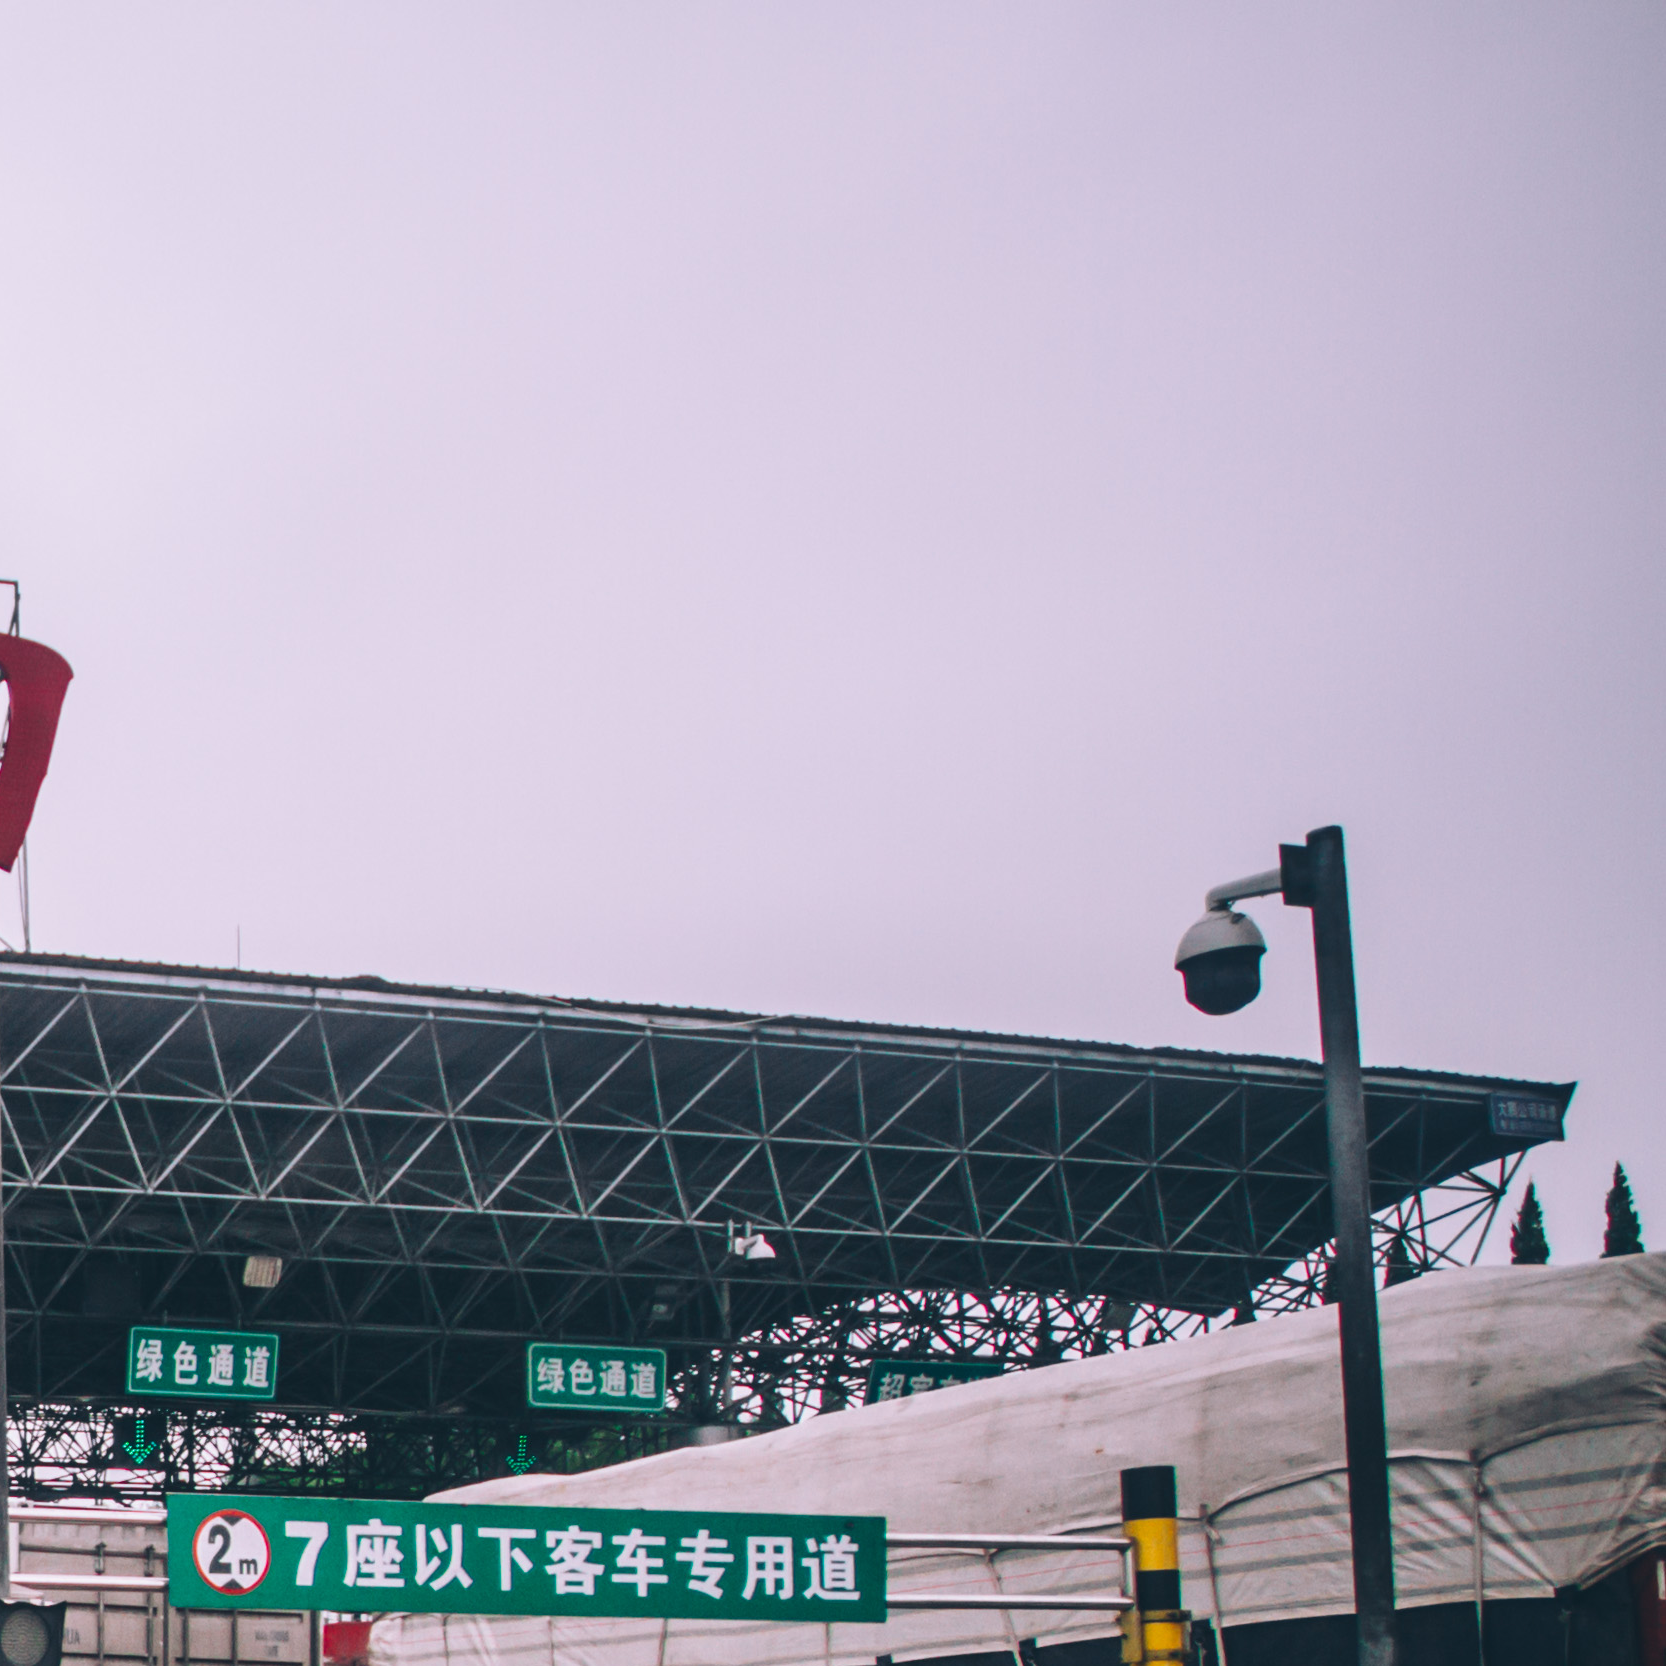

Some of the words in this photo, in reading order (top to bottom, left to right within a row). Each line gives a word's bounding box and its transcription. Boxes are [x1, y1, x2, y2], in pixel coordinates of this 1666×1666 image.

[135, 1338, 271, 1389] 绿色通道
[536, 1355, 658, 1401] 绿色通道
[284, 1517, 861, 1602] 7座以下客车专用道
